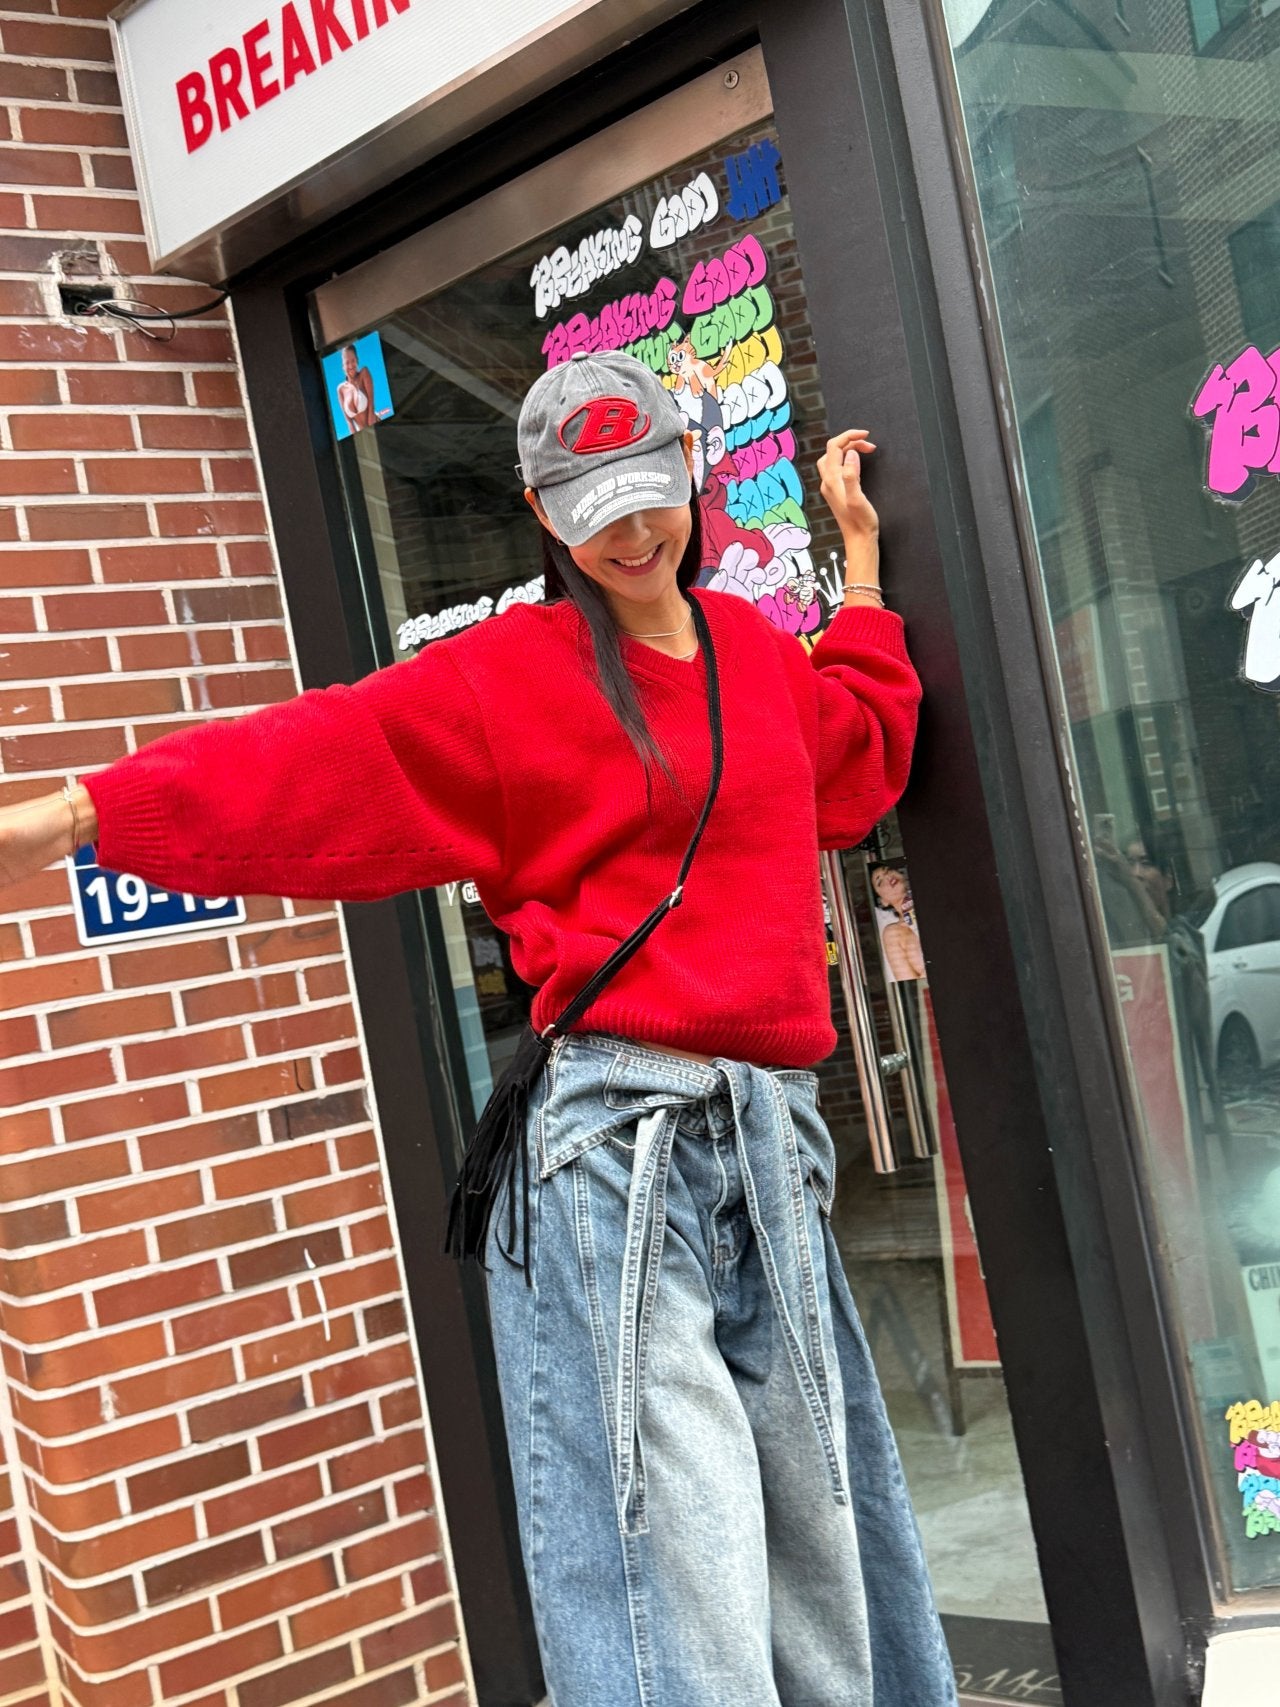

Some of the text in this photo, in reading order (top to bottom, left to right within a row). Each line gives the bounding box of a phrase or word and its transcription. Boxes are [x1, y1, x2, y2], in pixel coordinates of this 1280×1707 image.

[530, 172, 718, 318] BREAKING GOOD
[682, 234, 767, 314] GOOD
[396, 596, 493, 650] BREAKING
[1248, 1265, 1280, 1292] CHI
